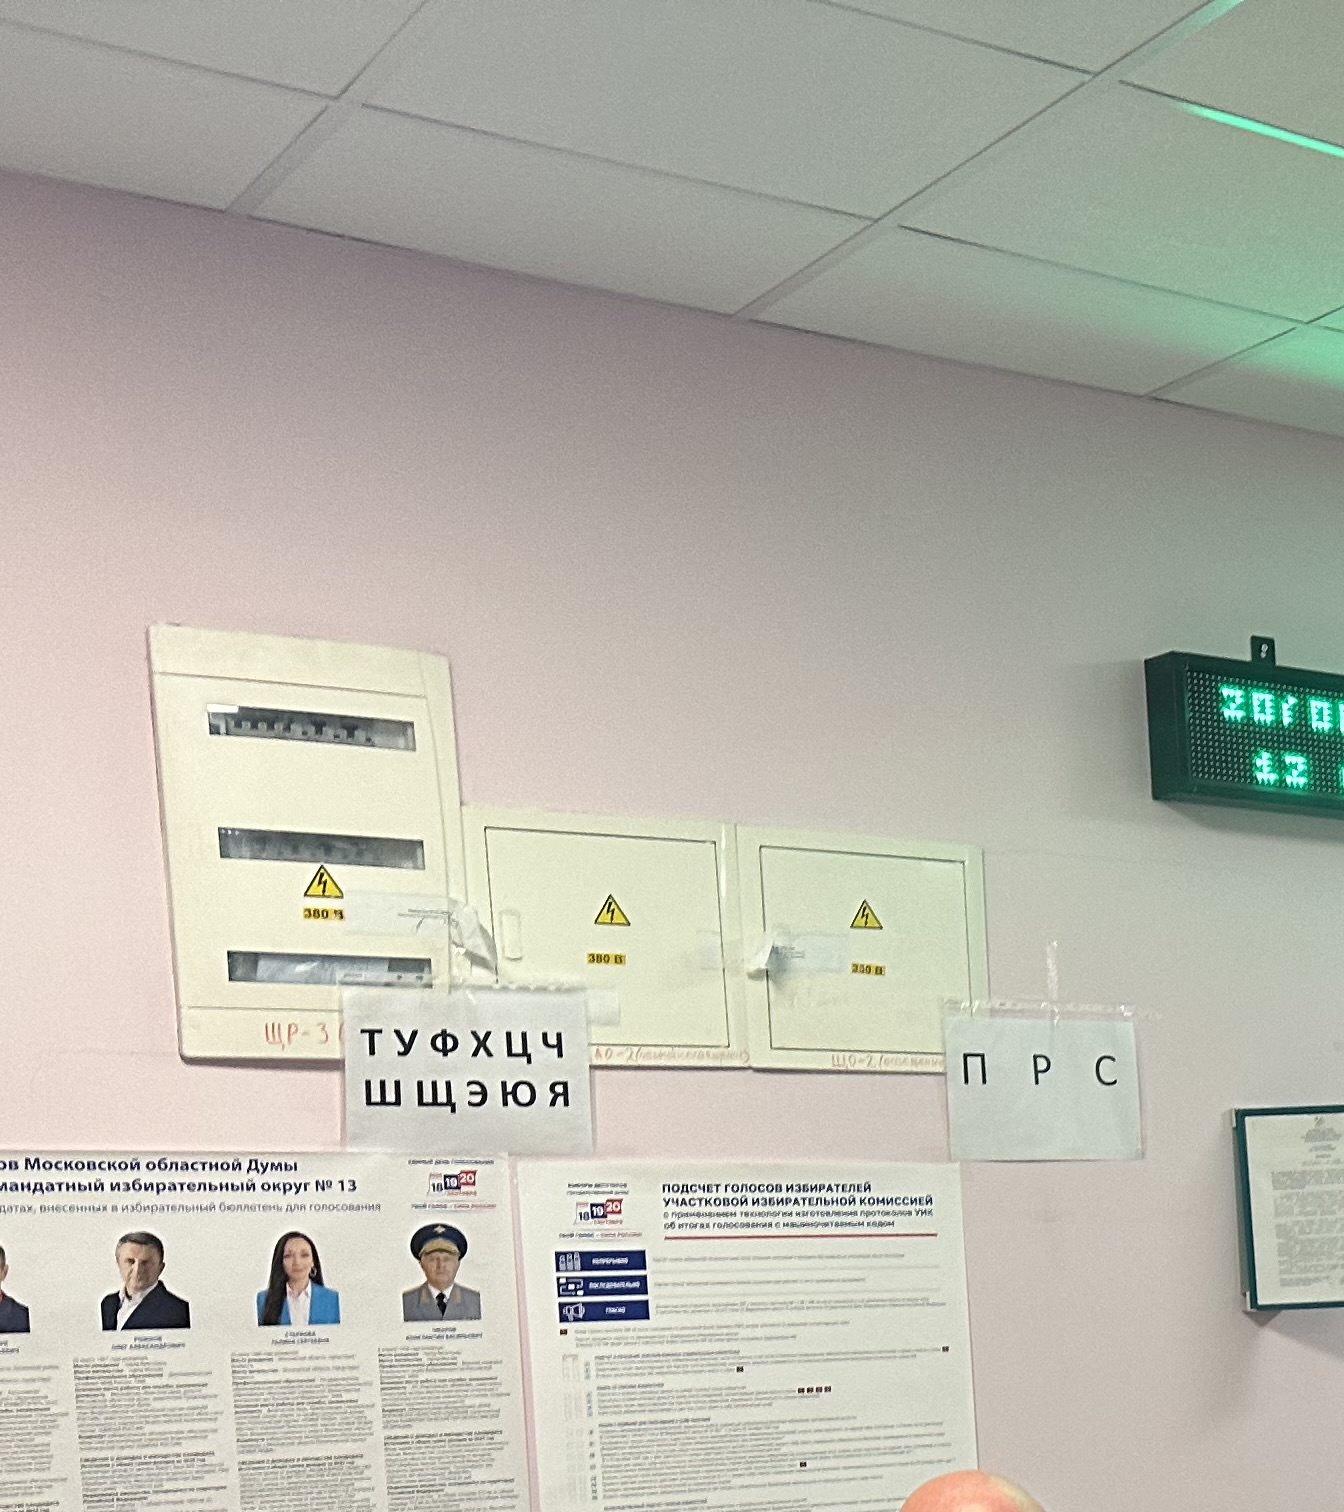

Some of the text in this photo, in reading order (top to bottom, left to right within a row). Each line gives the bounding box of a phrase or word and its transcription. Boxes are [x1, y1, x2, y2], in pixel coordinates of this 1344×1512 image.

[24, 1157, 141, 1172] Московской
[145, 1157, 242, 1172] областной
[246, 1158, 298, 1174] Думы
[459, 1173, 475, 1184] 20
[110, 1178, 256, 1195] избирательный
[260, 1182, 310, 1196] округ
[315, 1179, 333, 1192] №
[337, 1179, 358, 1192] 13
[662, 1181, 872, 1195] ПОДСЧЕТ ГОЛОСОВ ИЗБИРАТЕЛЕЙ
[606, 1201, 621, 1212] 20
[663, 1193, 933, 1207] УЧАСТКОВОЙ ИЗБИРАТЕЛЬНОЙ КОМИССИЕЙ
[40, 1204, 107, 1213] внесенных
[121, 1201, 216, 1214] избирательный
[219, 1201, 283, 1213] бюллетень
[285, 1204, 307, 1213] для
[309, 1202, 381, 1213] голосования
